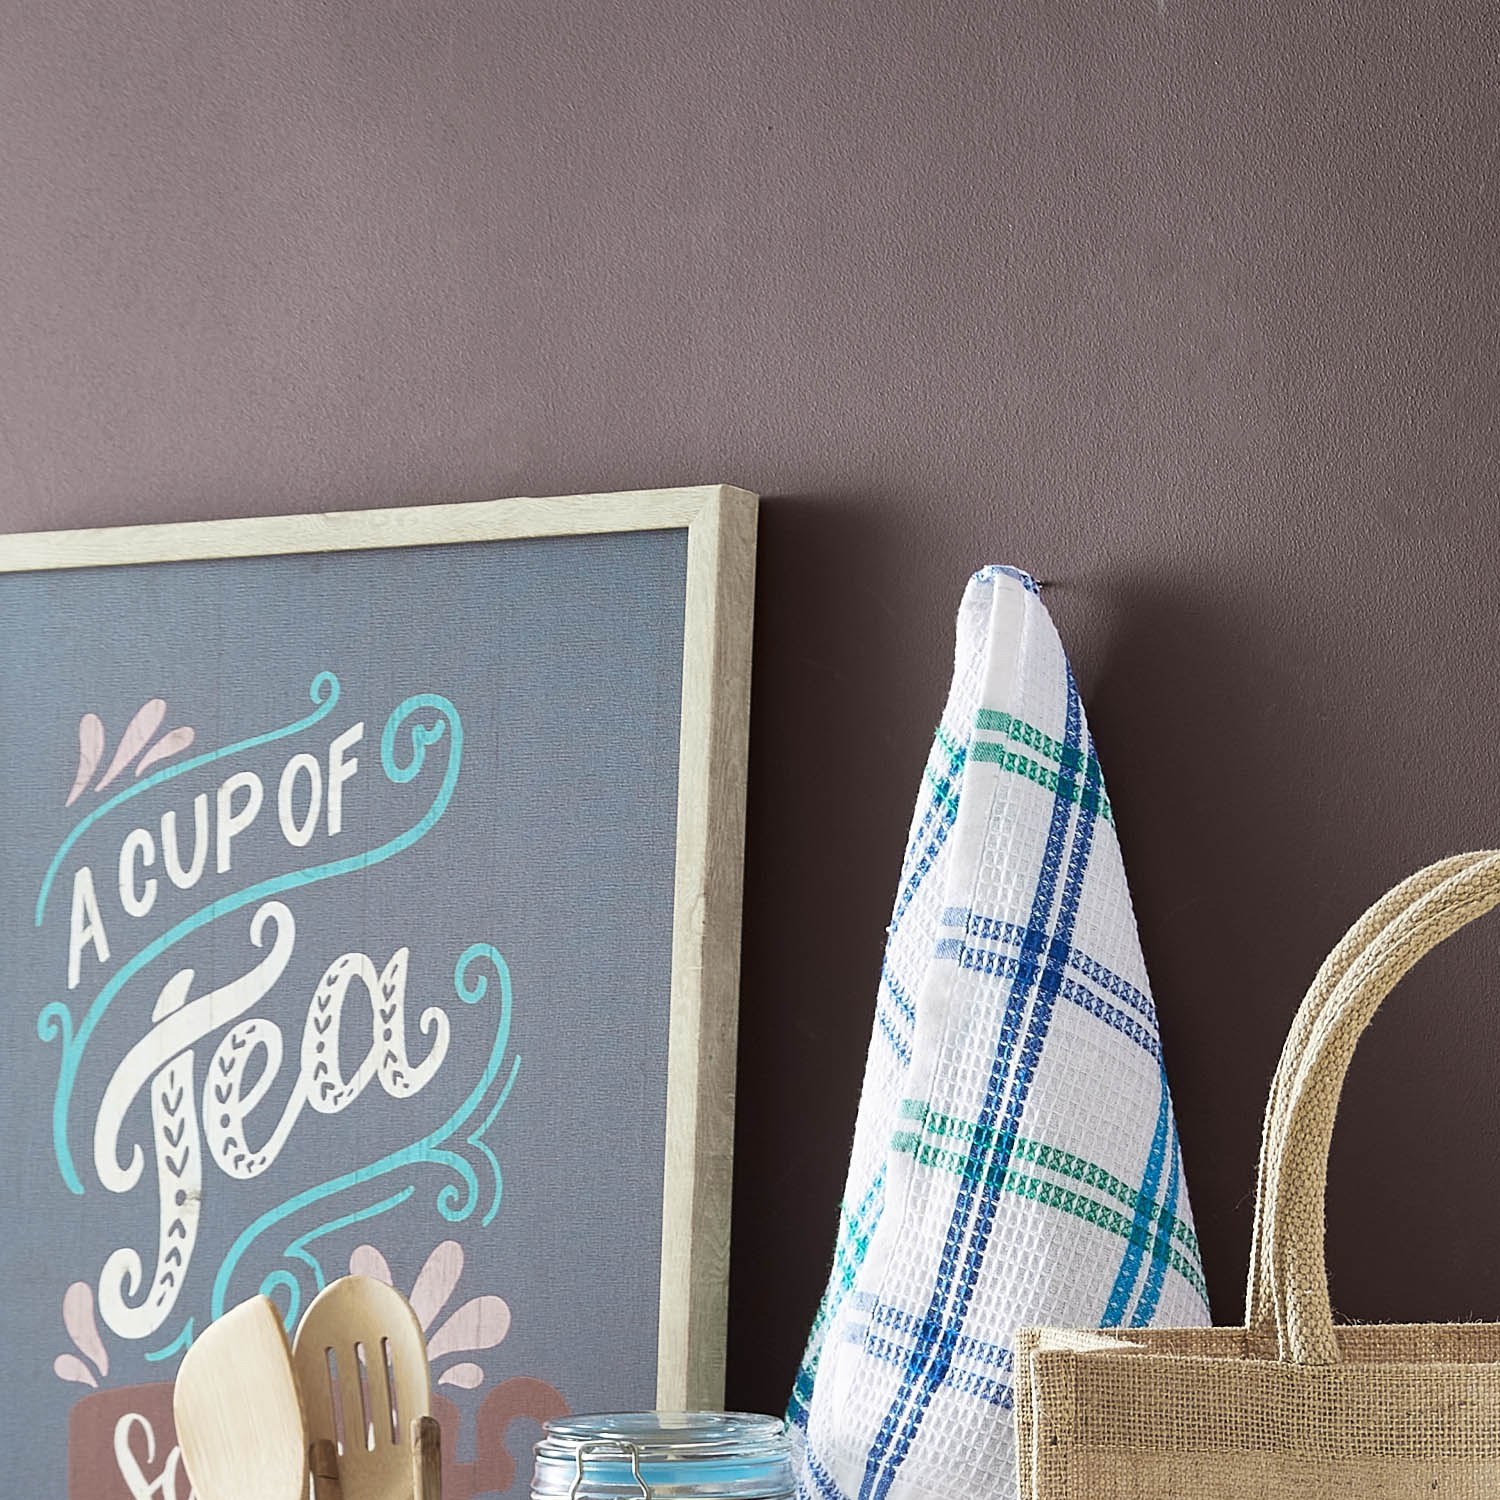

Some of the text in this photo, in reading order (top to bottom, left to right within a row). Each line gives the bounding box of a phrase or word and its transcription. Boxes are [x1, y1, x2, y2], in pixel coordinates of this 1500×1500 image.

[68, 722, 364, 989] A CUP OF
[94, 901, 450, 1339] Tea
